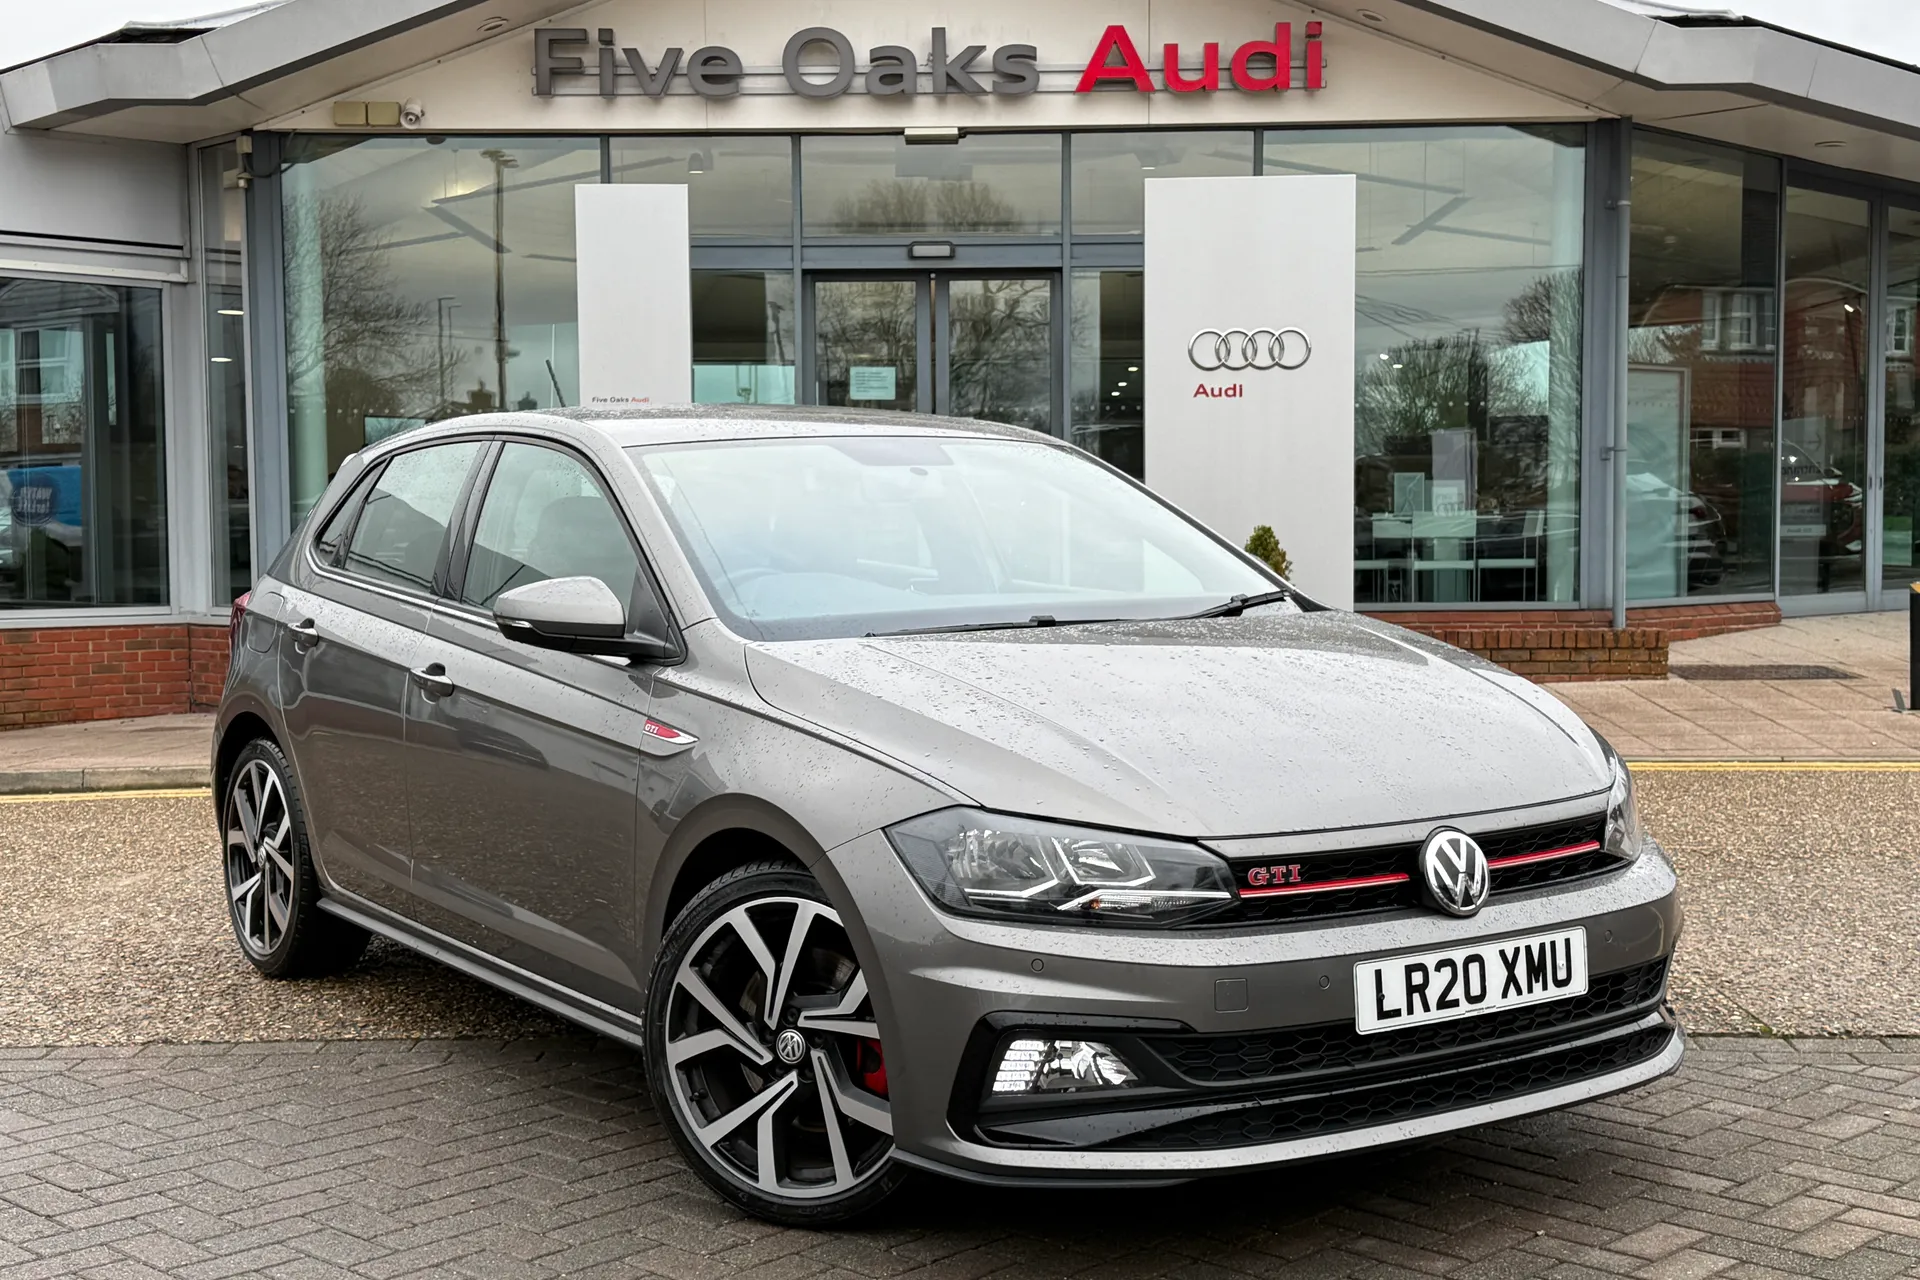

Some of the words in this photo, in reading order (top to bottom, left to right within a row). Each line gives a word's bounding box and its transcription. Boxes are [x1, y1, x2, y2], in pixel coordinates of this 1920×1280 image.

[533, 28, 743, 96] Five
[781, 27, 1040, 97] Oaks
[1074, 21, 1324, 93] Audi
[1193, 383, 1243, 398] Audi
[644, 723, 659, 733] GTI
[1247, 864, 1302, 886] GTI
[1375, 953, 1487, 1020] LR20
[1499, 937, 1572, 999] XMU
